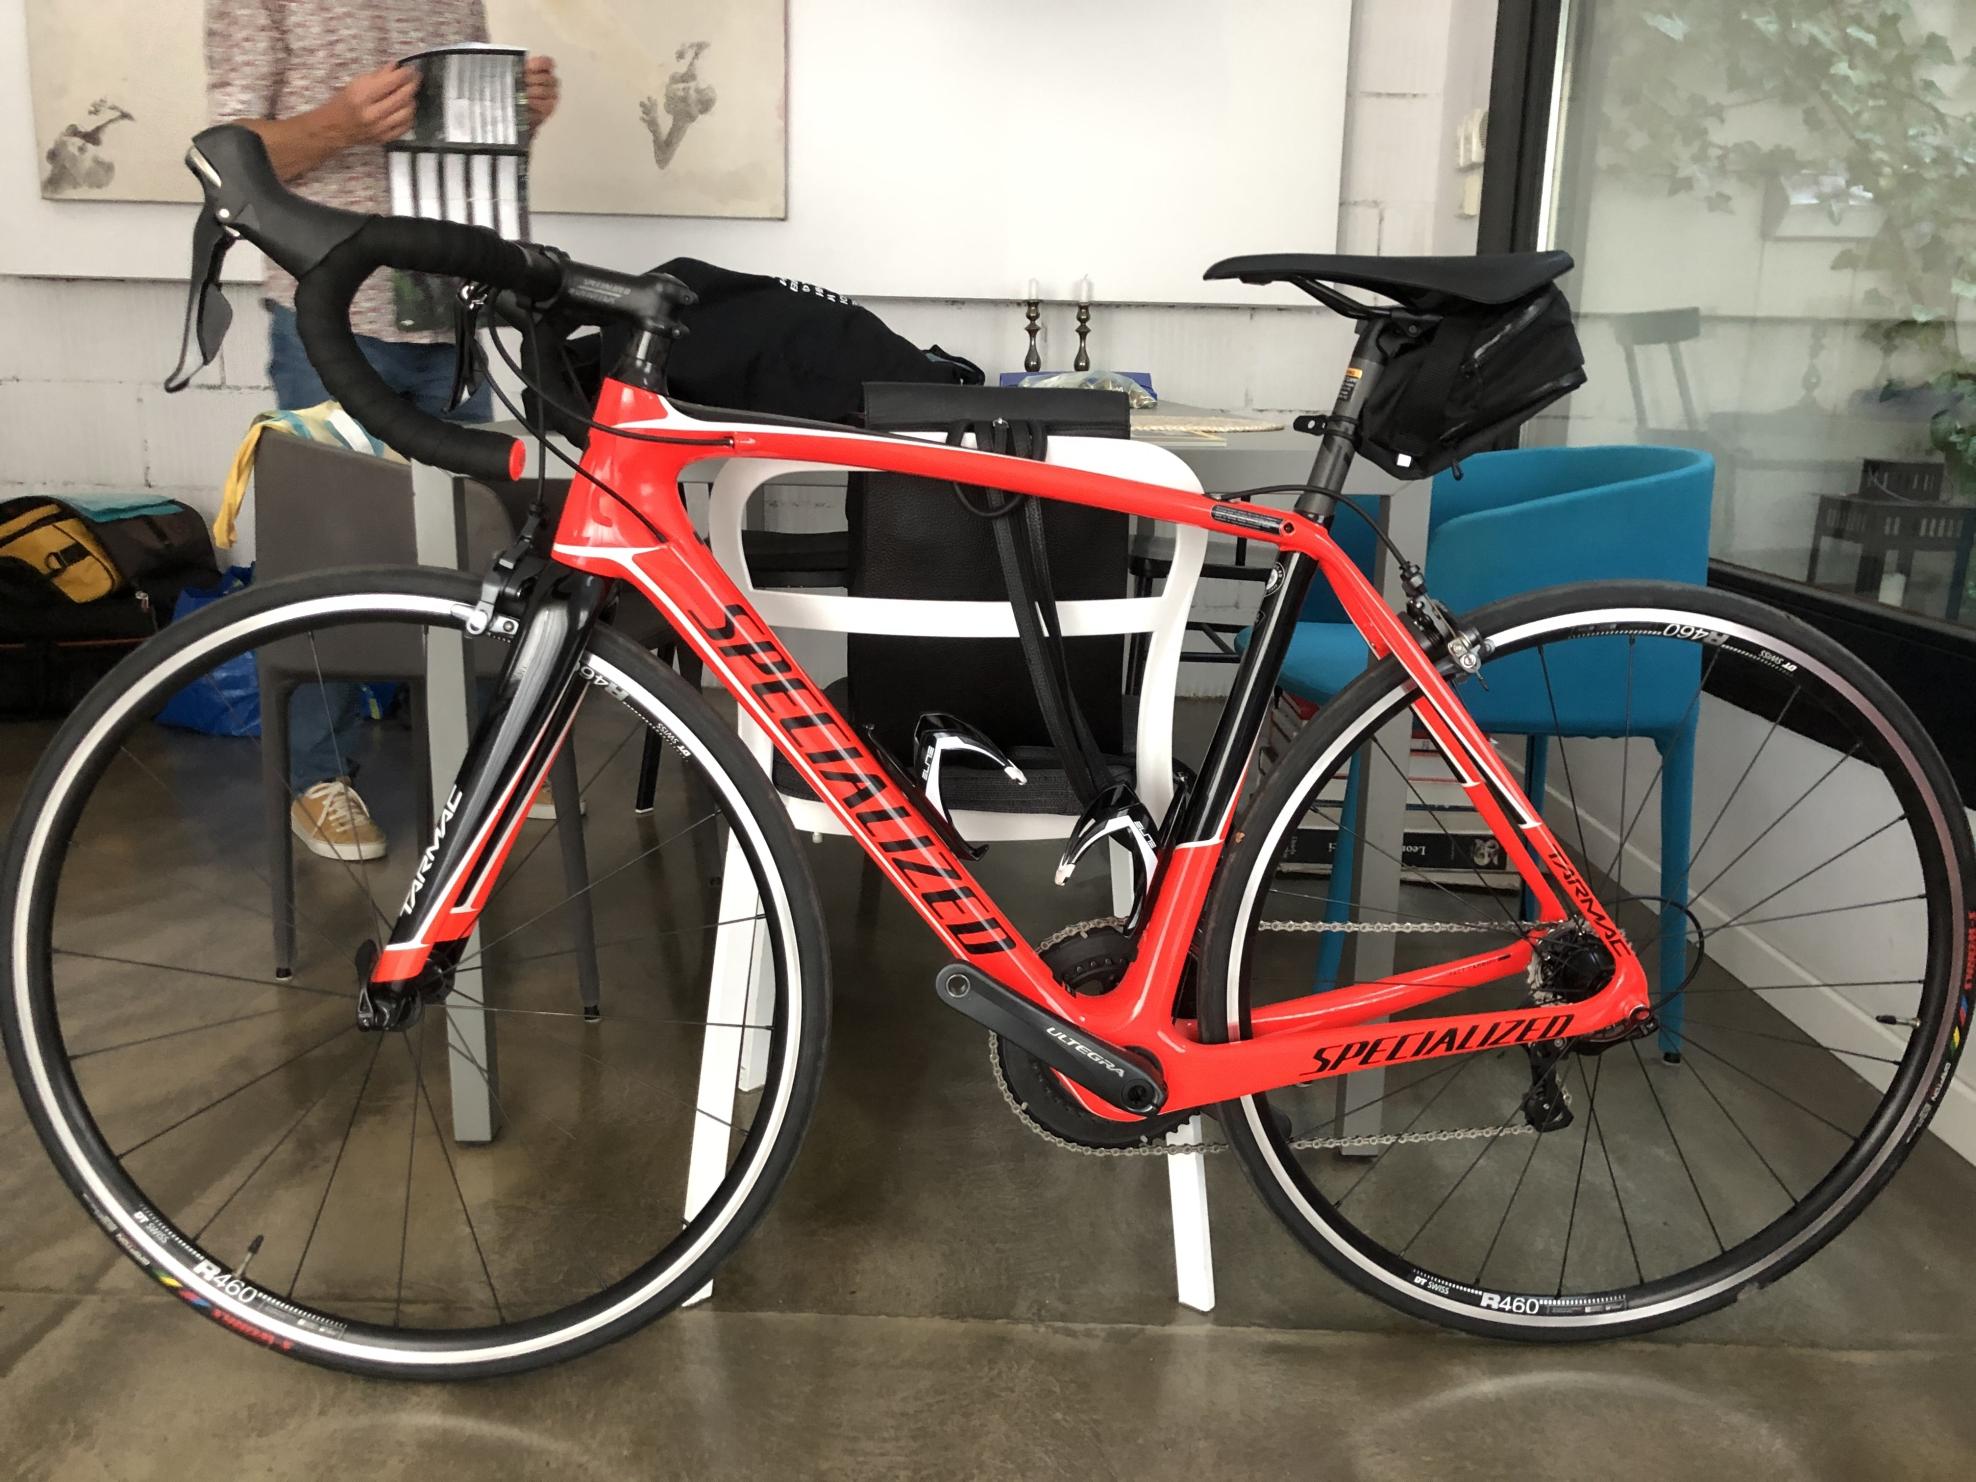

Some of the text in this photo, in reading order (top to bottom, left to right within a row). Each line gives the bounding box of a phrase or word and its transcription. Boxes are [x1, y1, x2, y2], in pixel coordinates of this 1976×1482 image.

[1663, 623, 1730, 646] R460
[1758, 650, 1785, 666] SWISS
[656, 722, 680, 744] SWISS
[688, 603, 1017, 955] SPECIALIZED
[400, 784, 463, 916] TARMAC
[1549, 844, 1632, 957] TARMAC
[1046, 1026, 1125, 1078] ULTEGRA
[1298, 1013, 1575, 1076] SPECIALIZED
[134, 1210, 149, 1225] DT
[148, 1222, 169, 1244] SWISS
[192, 1258, 258, 1304] R460
[1414, 1276, 1450, 1295] DT SWISS
[1480, 1292, 1540, 1314] R460
